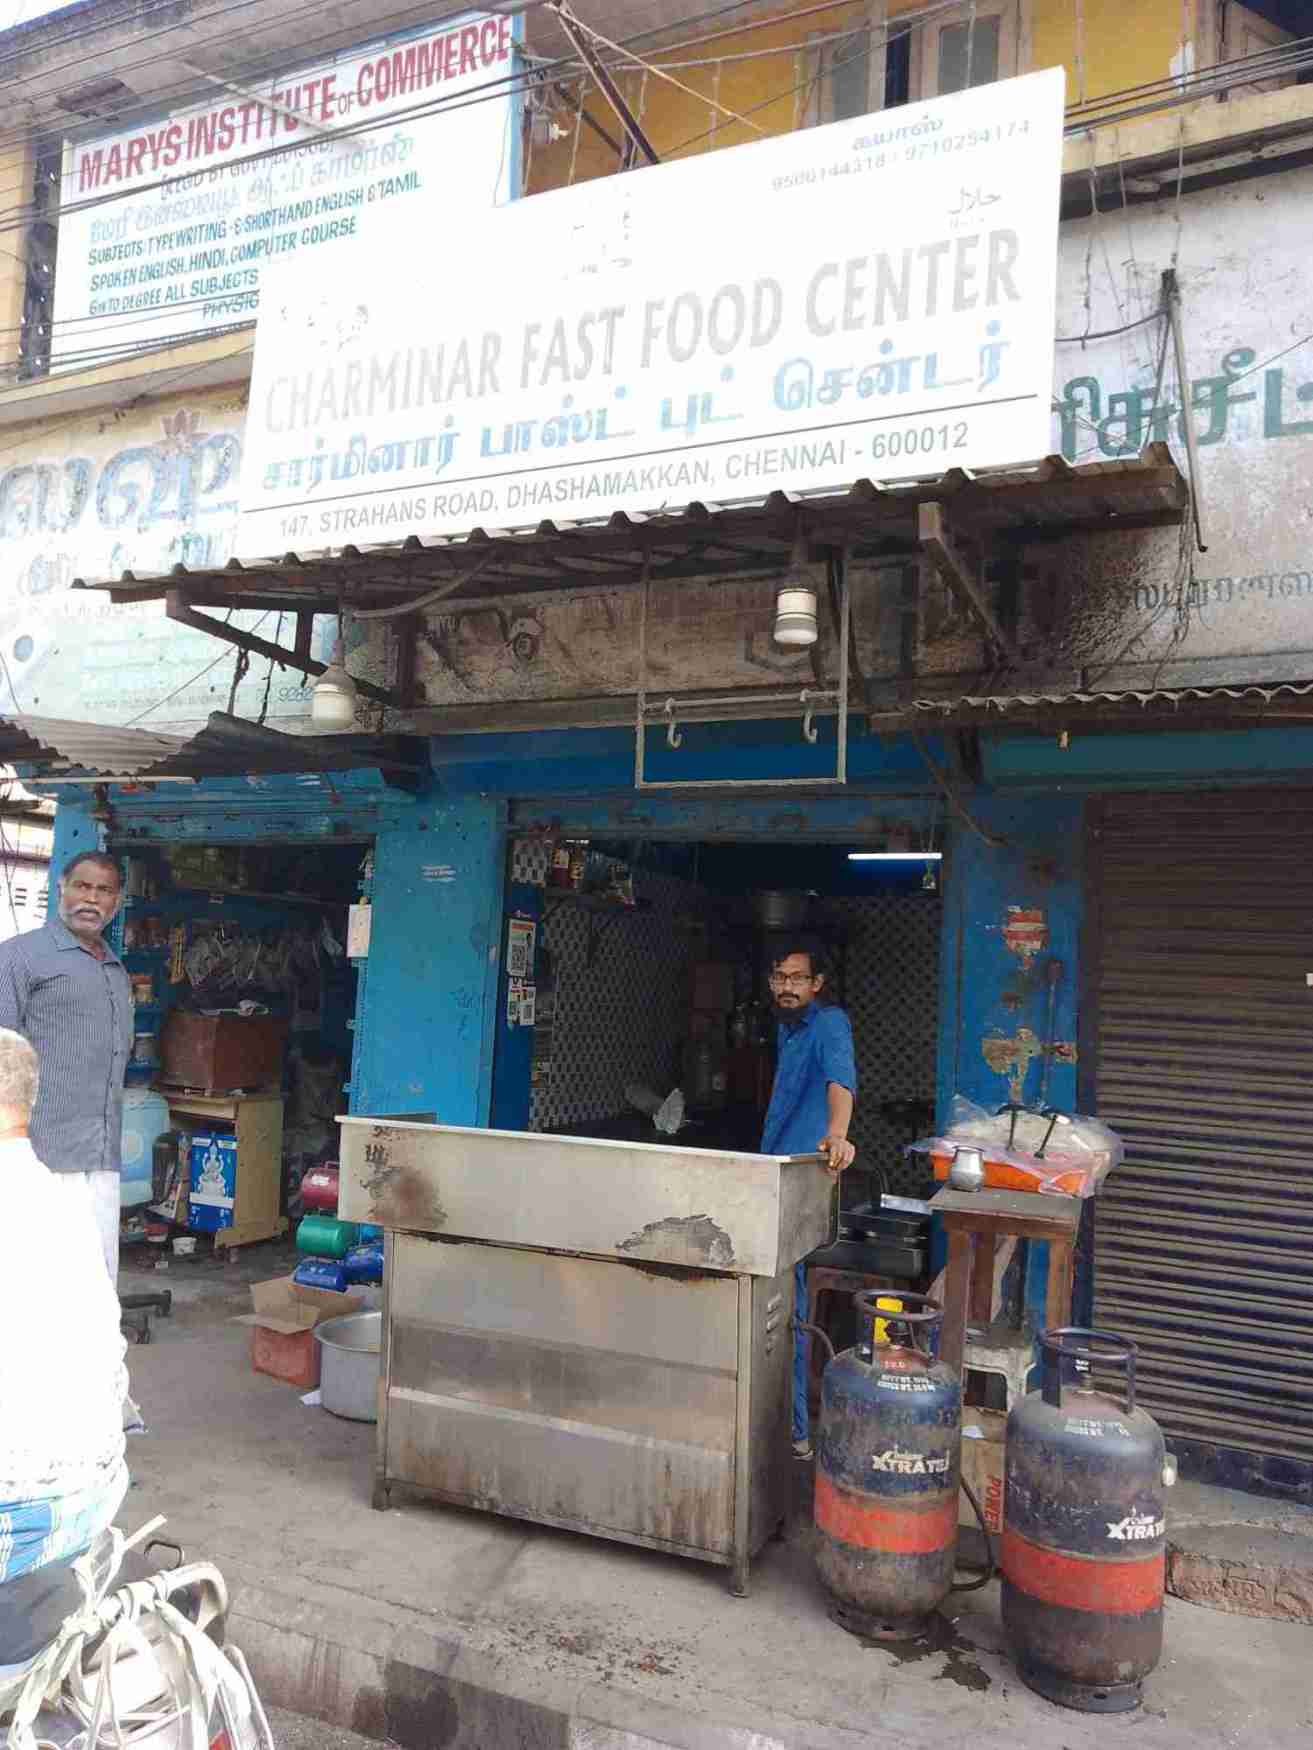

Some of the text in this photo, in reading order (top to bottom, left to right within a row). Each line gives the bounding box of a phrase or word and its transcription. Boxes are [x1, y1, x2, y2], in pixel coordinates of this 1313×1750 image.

[186, 74, 337, 160] INSTITUTE
[338, 90, 356, 115] OF
[356, 13, 512, 107] COMMERCE
[244, 204, 313, 235] SHORTHAND
[314, 190, 364, 220] ENGLISH
[377, 171, 423, 198] TAMIL
[90, 263, 137, 293] SPOKEN
[230, 231, 298, 264] COMPUTER
[301, 216, 358, 247] COURSE
[164, 281, 187, 304] ALL
[188, 269, 260, 300] SUBJECTS
[264, 226, 1022, 434] CHARMINAR FAST FOOD CENTER
[772, 319, 1011, 411] சென்டர்
[320, 496, 428, 533] STRAHANS
[726, 438, 846, 480] CHENNAI
[871, 421, 969, 460] 600012
